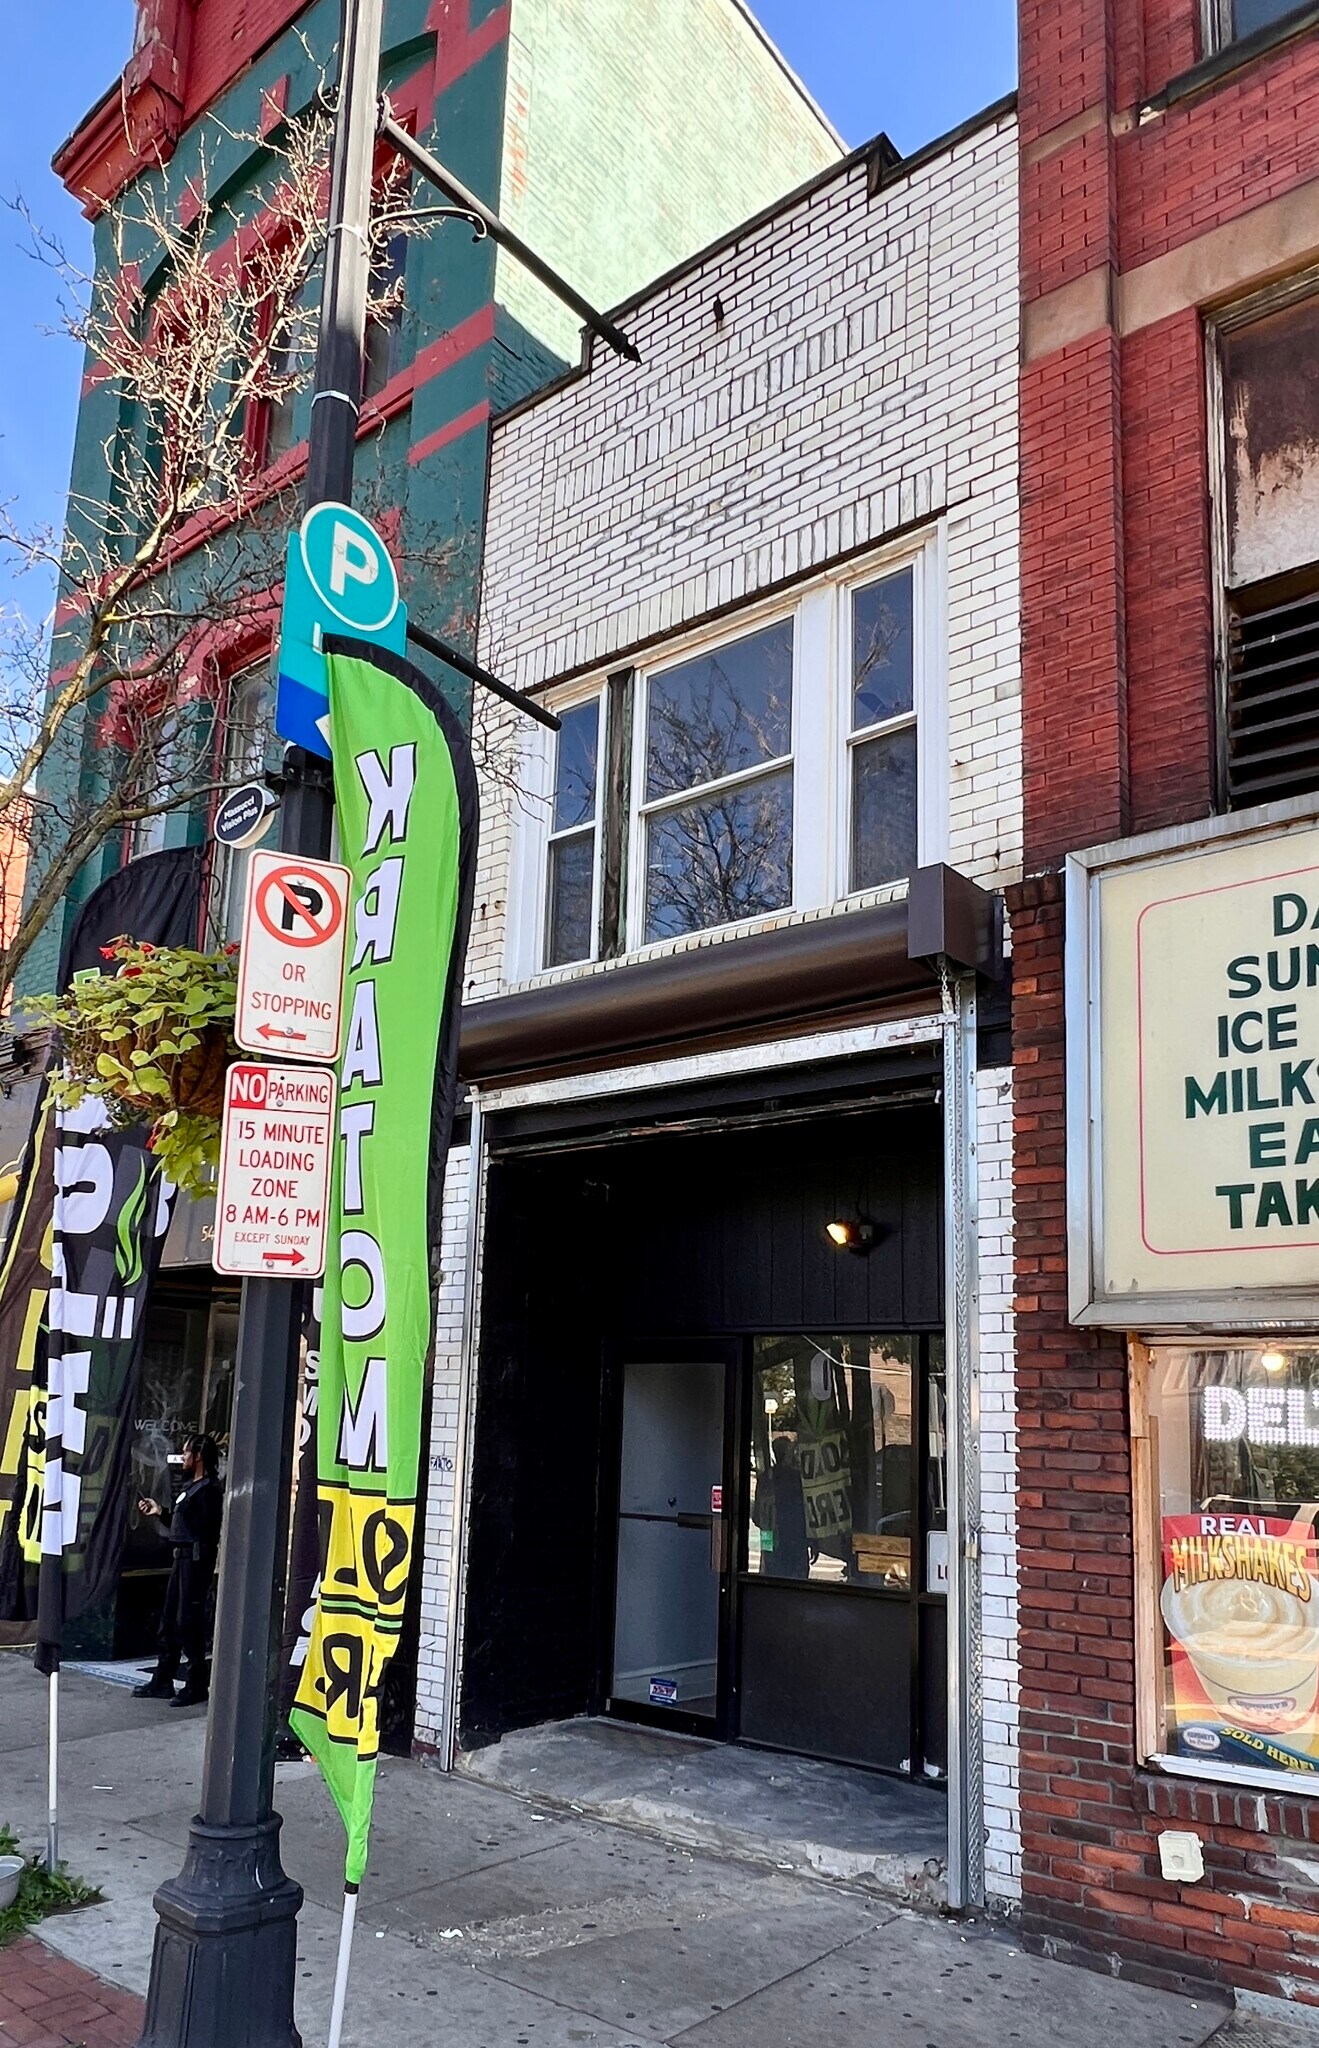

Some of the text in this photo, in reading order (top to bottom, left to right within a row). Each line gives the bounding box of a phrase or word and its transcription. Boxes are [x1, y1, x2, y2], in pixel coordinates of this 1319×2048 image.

[1272, 893, 1319, 937] D
[282, 962, 306, 983] OR
[251, 991, 333, 1021] STOPPING
[1217, 1003, 1298, 1058] ICE
[231, 1072, 329, 1104] NO PARKING
[1184, 1057, 1319, 1120] MILK
[237, 1120, 325, 1145] 15 MINUTE
[239, 1149, 315, 1172] LOADING
[250, 1178, 299, 1199] ZONE
[225, 1204, 237, 1223] 8
[295, 1208, 321, 1228] PM
[234, 1231, 311, 1246] EXCEPT SUNDAY
[134, 1419, 198, 1433] WELCOME
[1200, 1516, 1274, 1539] REAL
[1171, 1534, 1312, 1603] MILKSHAKES
[1219, 1727, 1265, 1751] SOLD
